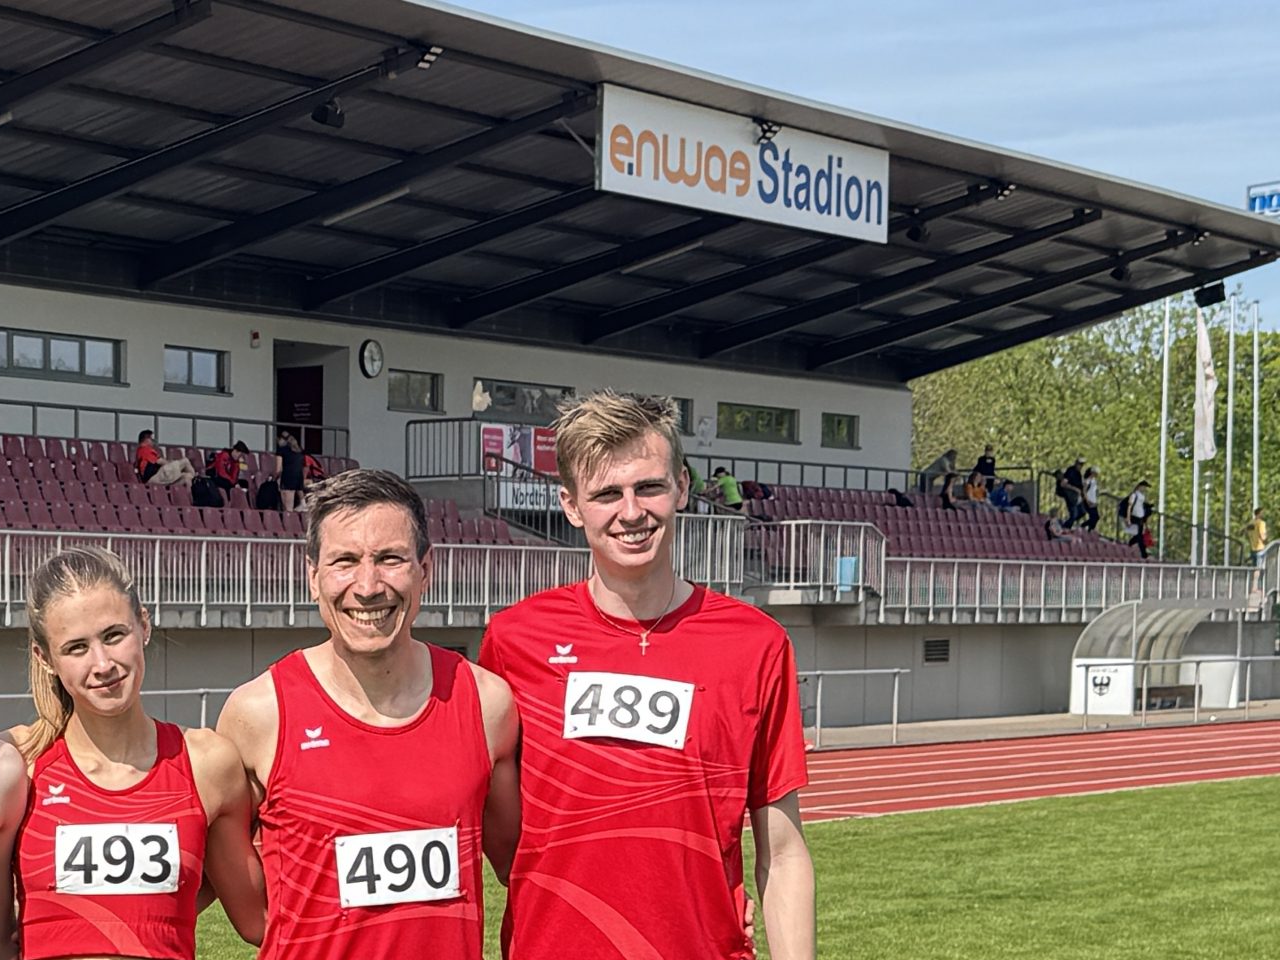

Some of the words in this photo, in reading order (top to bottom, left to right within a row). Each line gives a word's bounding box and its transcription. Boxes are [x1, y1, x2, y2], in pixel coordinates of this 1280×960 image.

[757, 142, 883, 225] Stadion
[571, 683, 681, 735] 489
[63, 834, 172, 884] 493
[346, 840, 451, 895] 490
